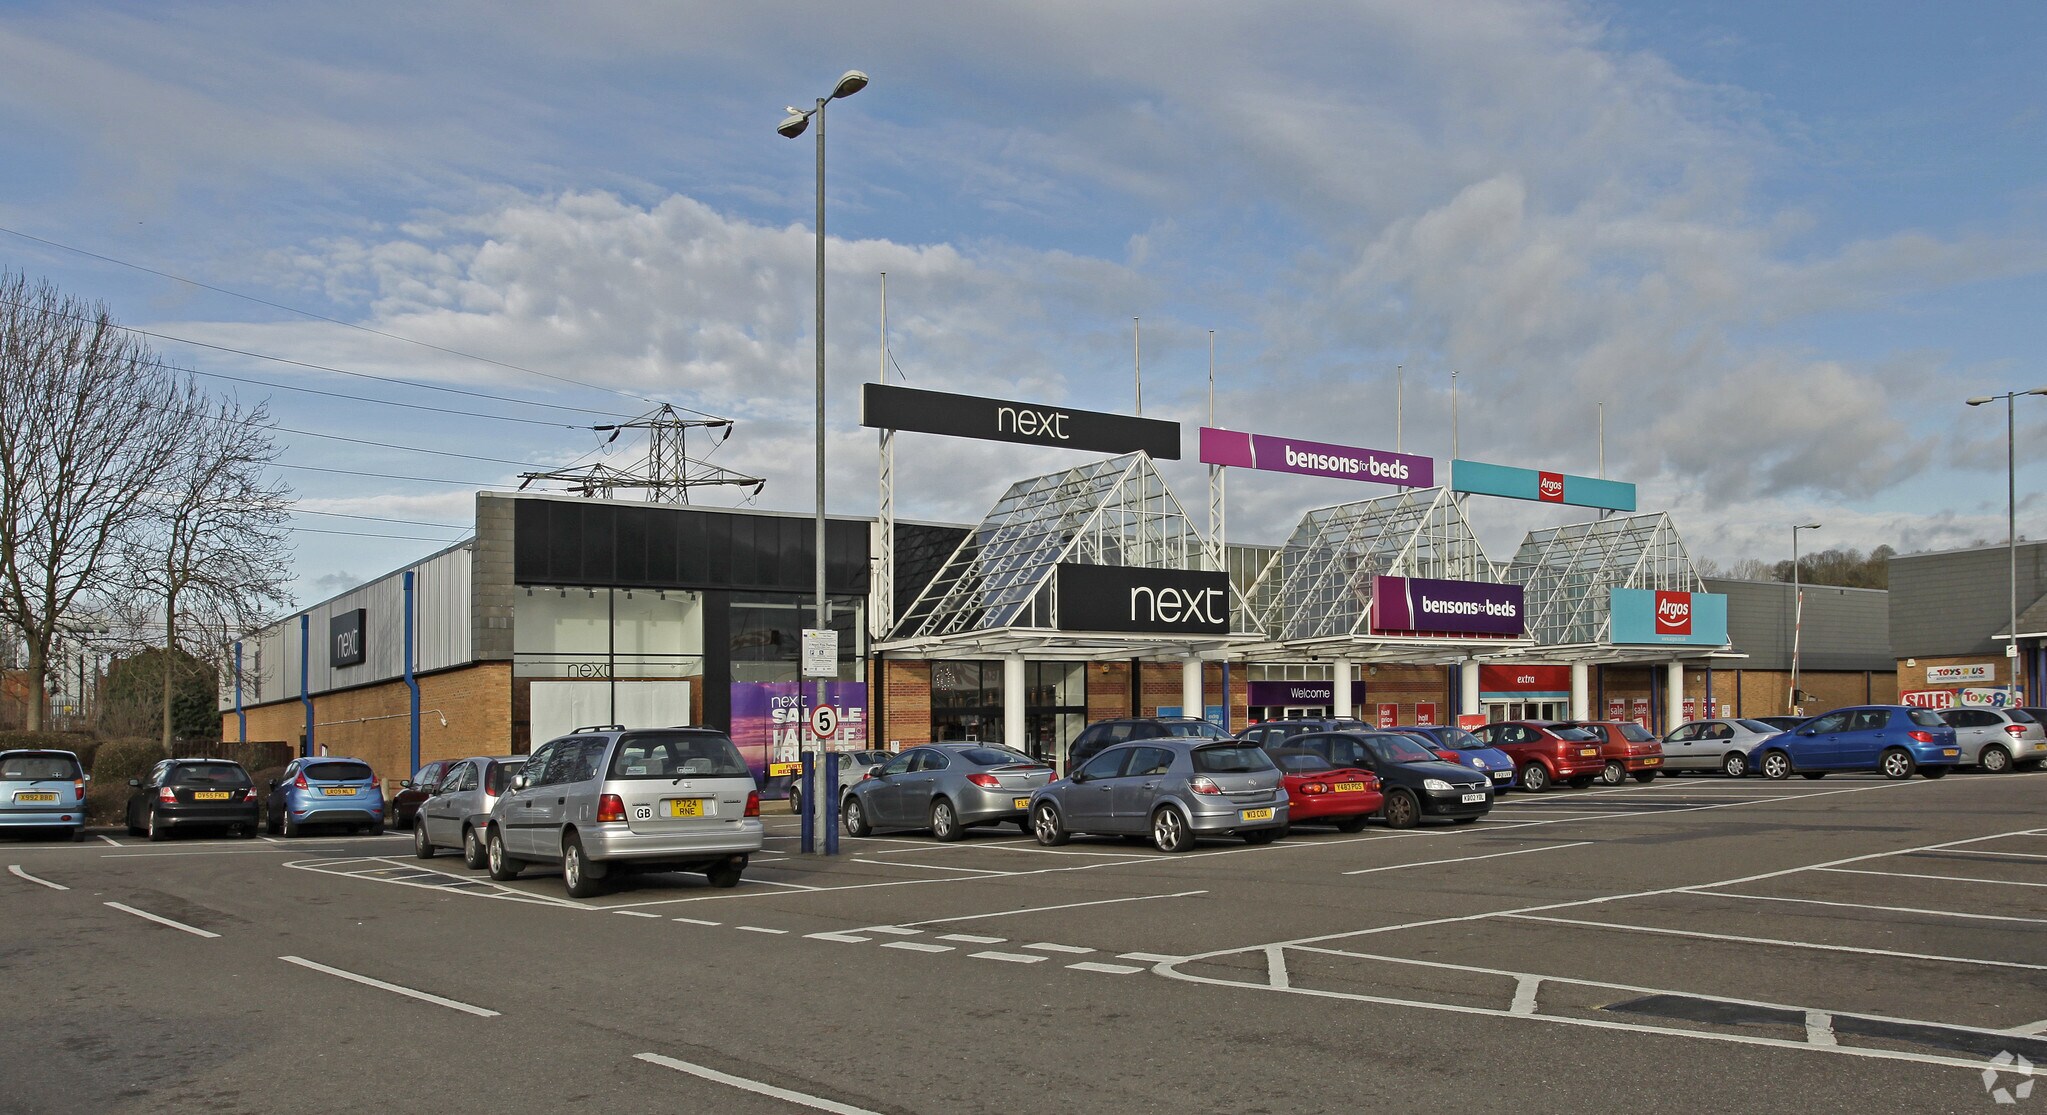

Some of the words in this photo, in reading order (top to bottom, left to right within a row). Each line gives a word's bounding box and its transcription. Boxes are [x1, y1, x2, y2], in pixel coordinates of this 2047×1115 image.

[998, 407, 1070, 440] next
[1285, 445, 1359, 474] bensons
[1359, 460, 1369, 472] for
[1369, 455, 1409, 480] beds
[1541, 477, 1562, 492] Argos
[1131, 586, 1224, 624] next
[1422, 595, 1478, 615] bensons
[1478, 603, 1486, 612] for
[1485, 598, 1516, 617] beds
[1658, 598, 1689, 620] Argos
[337, 628, 358, 659] next
[567, 663, 610, 678] next
[1937, 668, 1961, 676] TOYS
[1972, 667, 1985, 675] US
[1517, 675, 1535, 684] extra
[1290, 688, 1330, 699] Welcome
[1905, 693, 1951, 709] SALE!
[771, 695, 807, 709] next
[1610, 706, 1623, 715] sale
[1634, 706, 1646, 715] sale
[819, 711, 831, 731] 5
[676, 800, 697, 808] P724
[637, 808, 651, 818] GB
[679, 808, 695, 816] RNE
